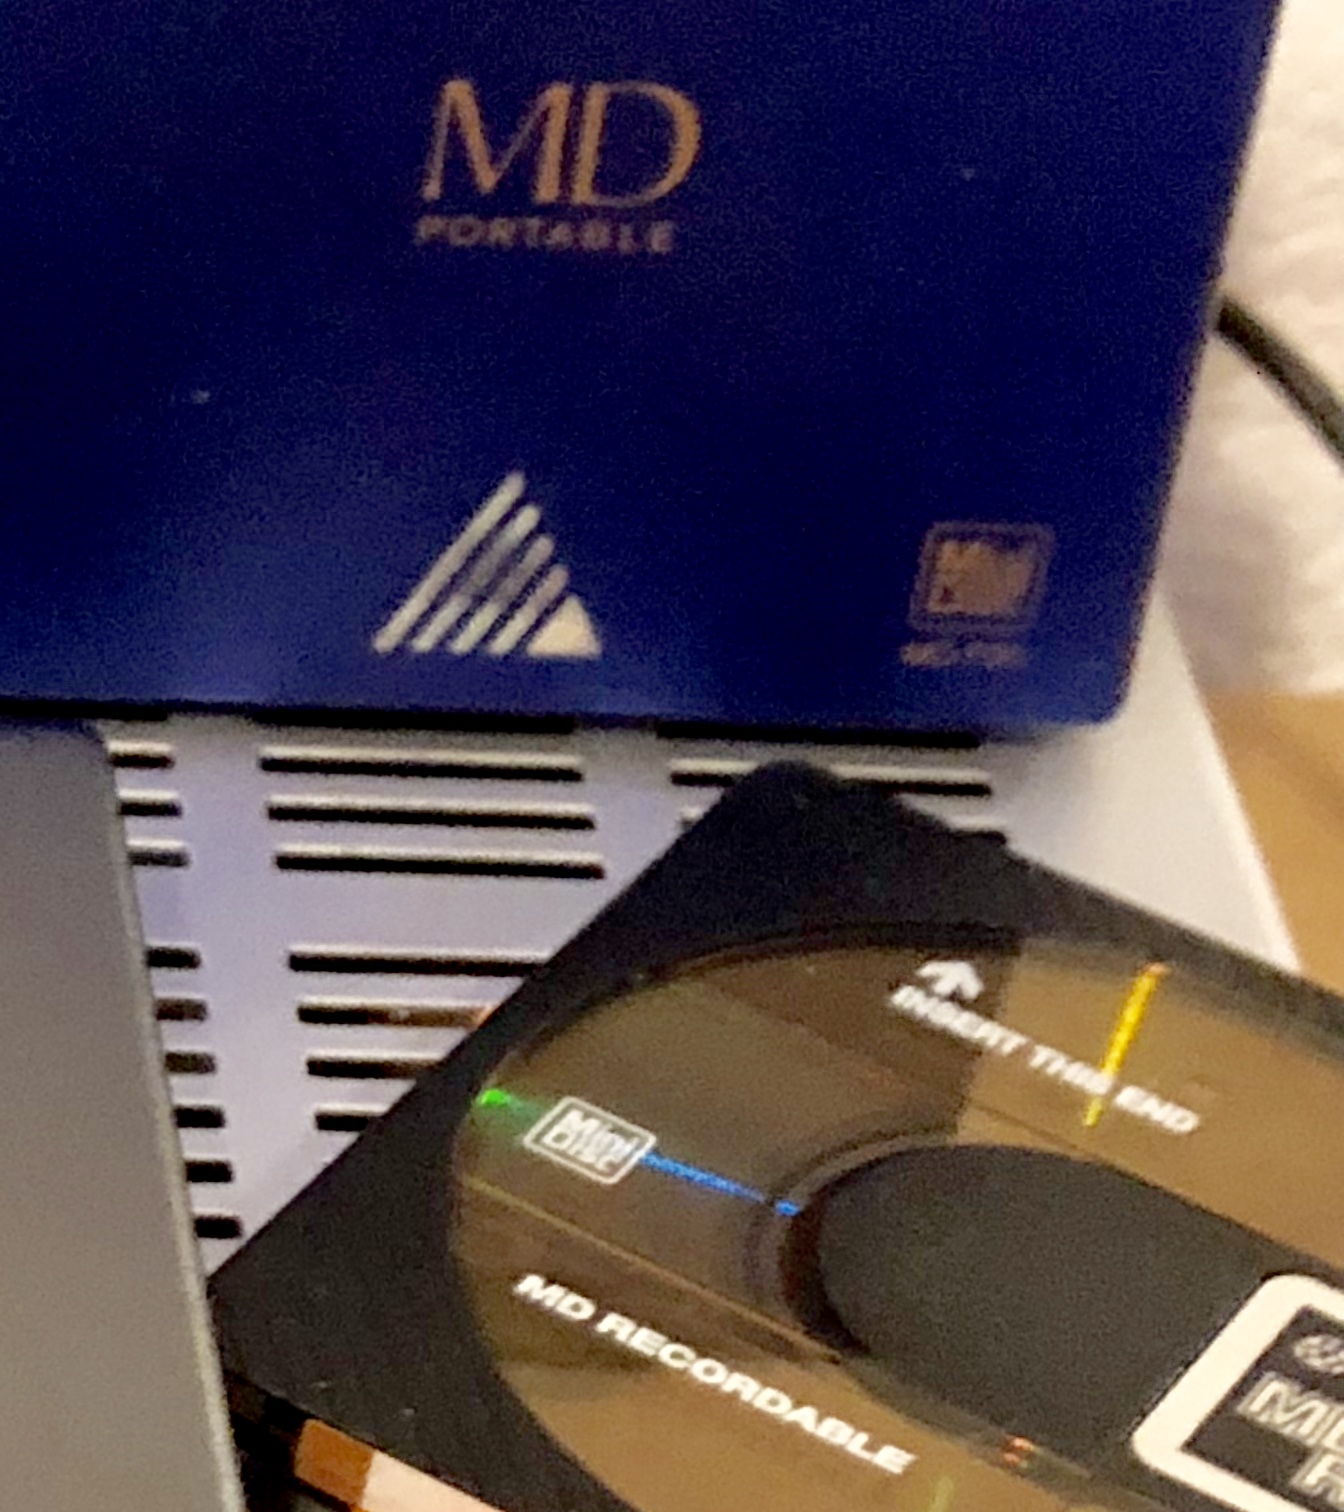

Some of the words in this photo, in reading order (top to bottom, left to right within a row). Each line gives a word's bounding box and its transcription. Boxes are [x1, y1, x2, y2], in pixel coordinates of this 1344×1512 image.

[422, 78, 703, 207] MD
[415, 214, 675, 253] PORTABLE
[514, 1274, 596, 1321] MD
[596, 1312, 919, 1475] RECORDABLE
